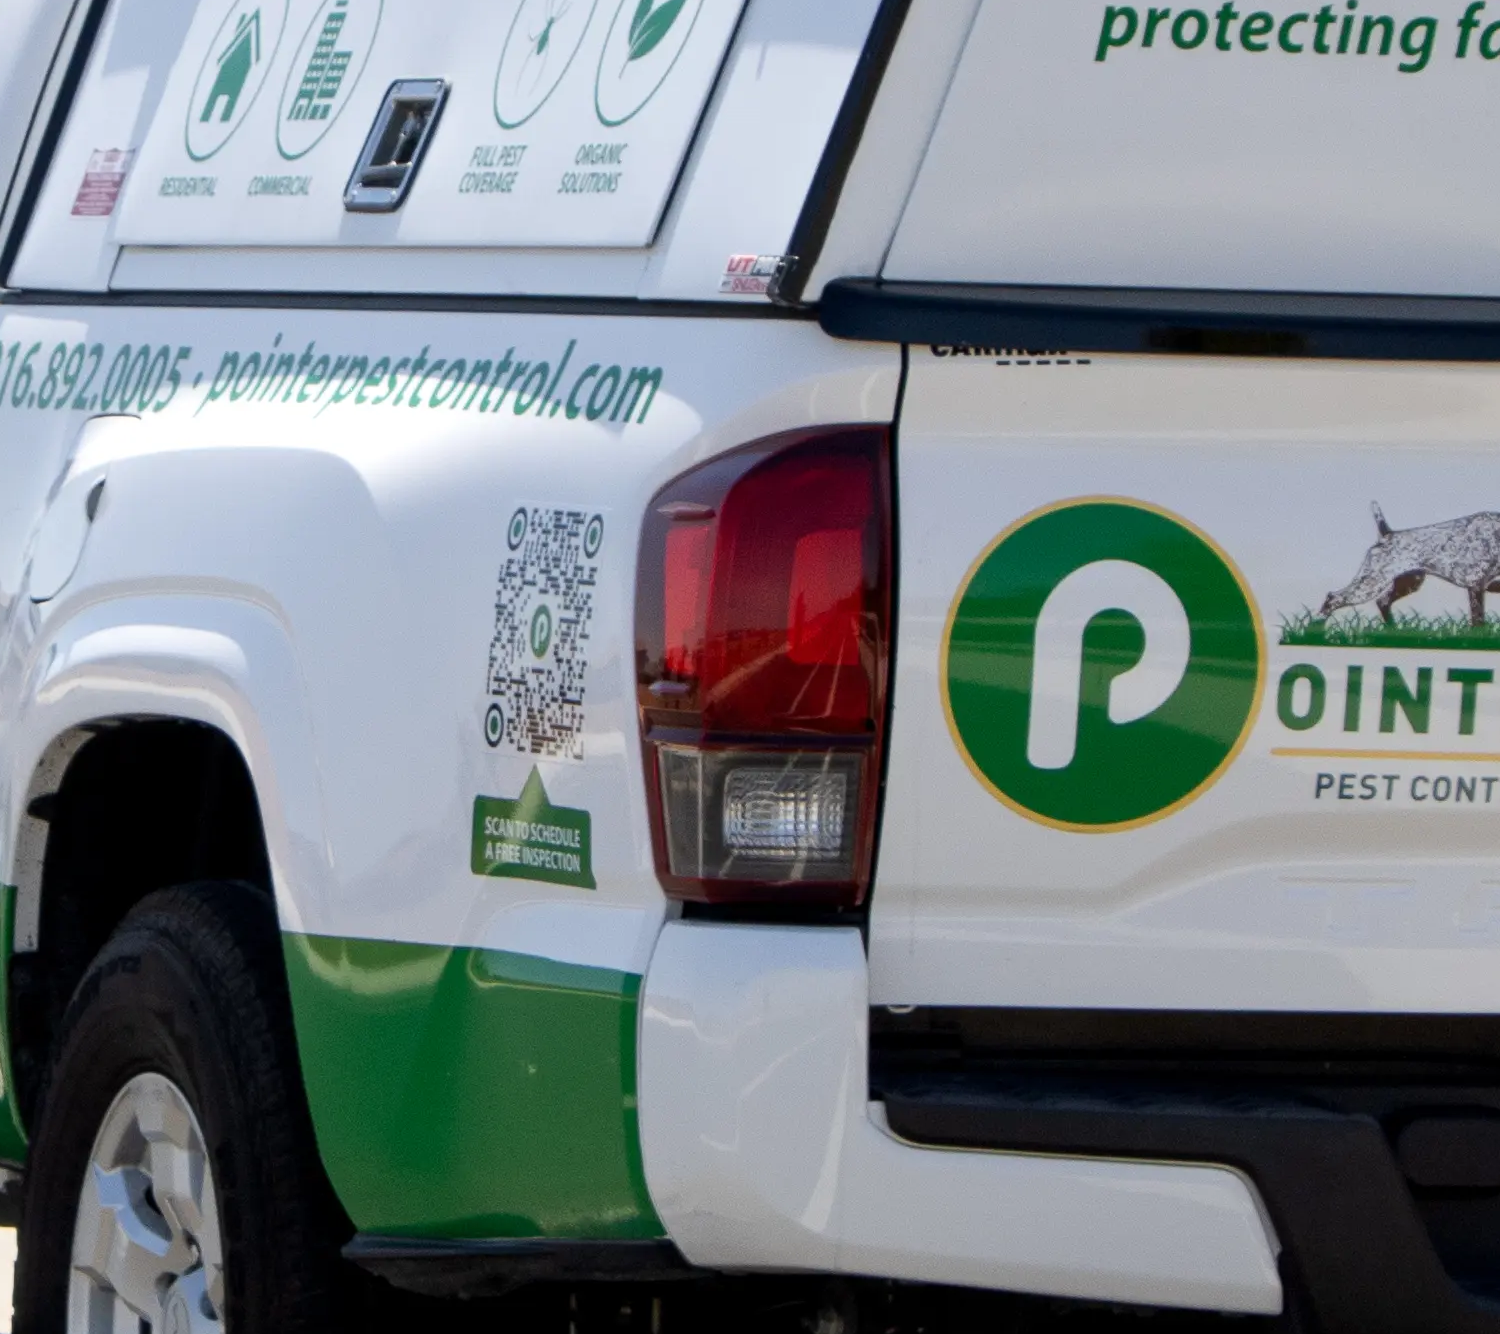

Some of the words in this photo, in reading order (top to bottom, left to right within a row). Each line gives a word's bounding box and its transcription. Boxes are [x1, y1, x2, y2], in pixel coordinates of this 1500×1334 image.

[1095, 0, 1438, 74] protecting
[468, 144, 499, 168] FULL
[497, 144, 529, 168] PEST
[574, 142, 629, 166] ORGANIC
[458, 170, 520, 194] COVERAGE
[557, 171, 623, 195] SOLUTIONS
[192, 331, 664, 424] pointerpestcontrol.com
[1028, 559, 1191, 769] P
[1315, 773, 1400, 800] PEST
[485, 816, 515, 838] SCAN
[515, 821, 530, 840] TO
[530, 823, 581, 848] SCHEDULE
[484, 841, 494, 860] A
[495, 843, 521, 863] FREE
[522, 846, 581, 873] INSPECTION
